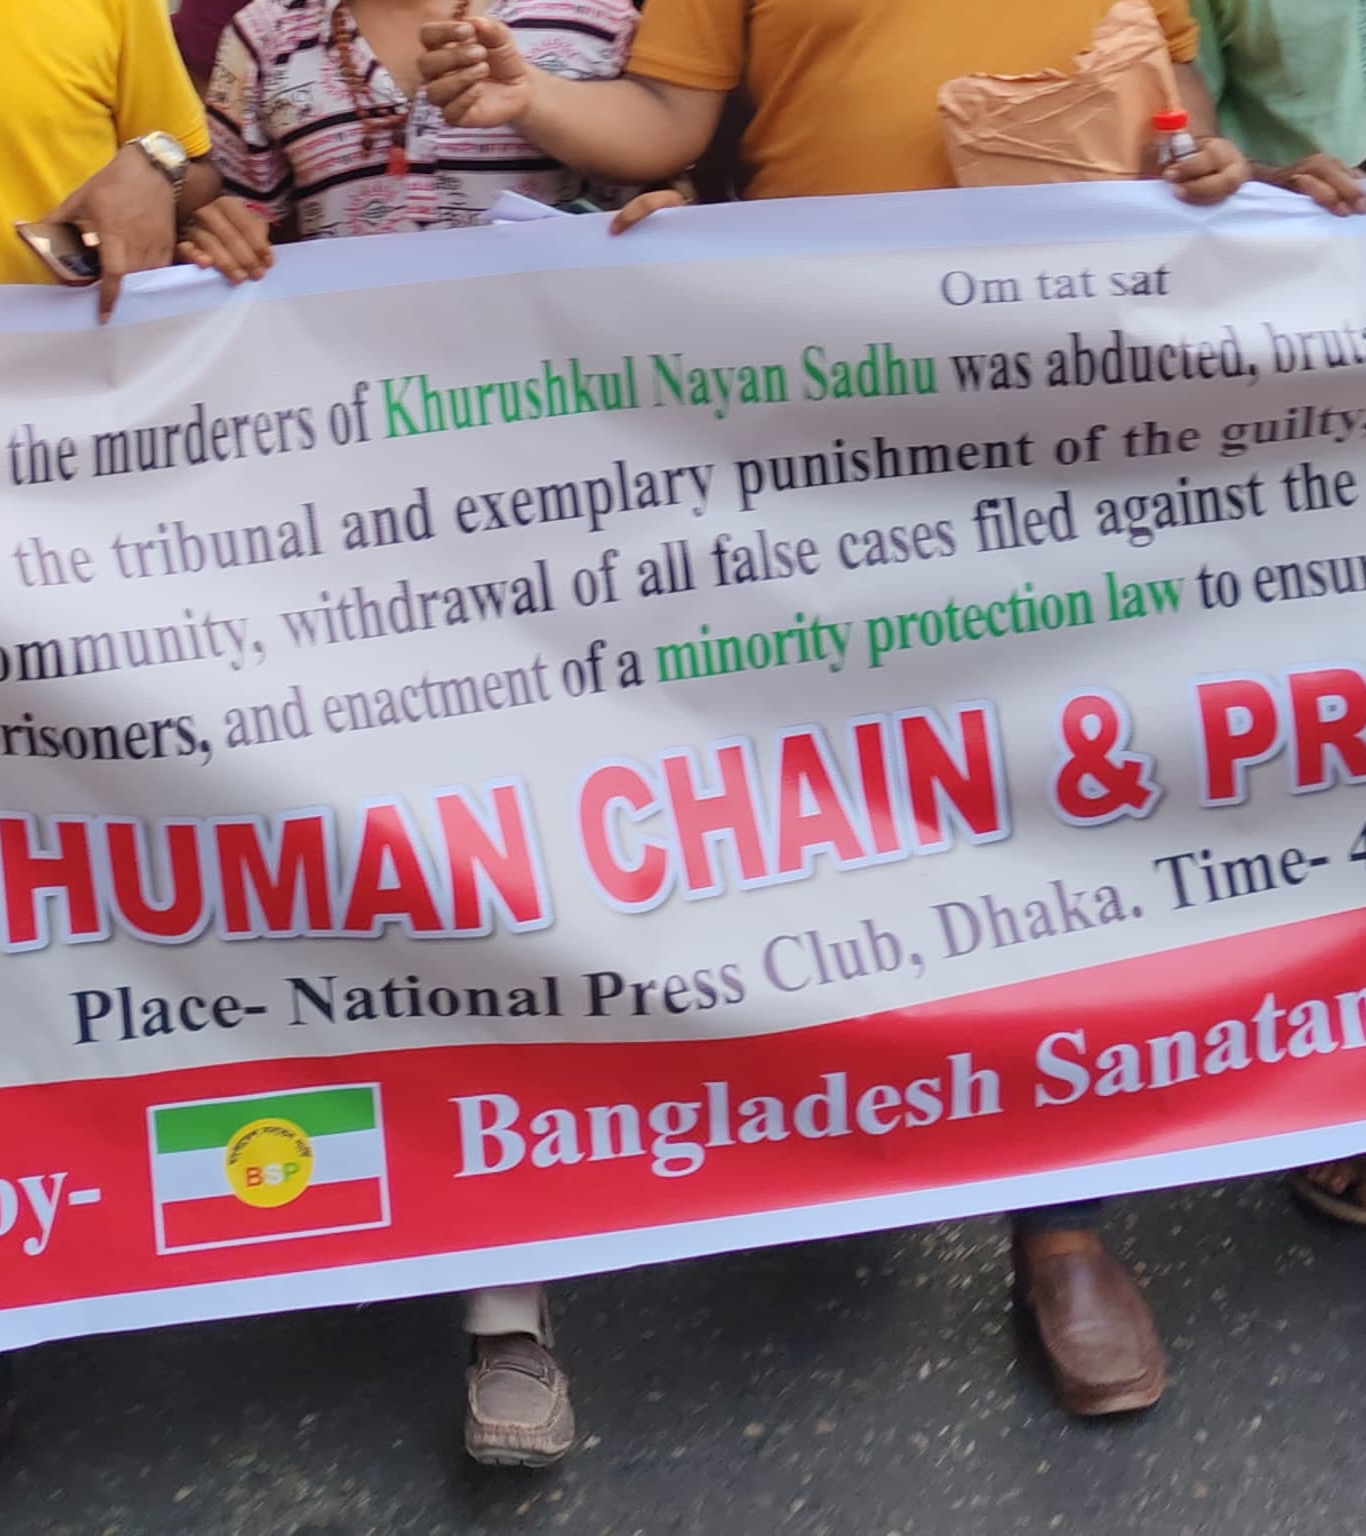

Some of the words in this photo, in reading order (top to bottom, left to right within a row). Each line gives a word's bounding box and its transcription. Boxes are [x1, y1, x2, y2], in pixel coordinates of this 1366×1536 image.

[941, 270, 1024, 306] Om
[1034, 267, 1096, 301] tat
[1109, 263, 1171, 298] sat
[9, 423, 76, 485] the
[92, 403, 314, 478] murderers
[329, 381, 371, 446] of
[380, 356, 641, 440] Khurushkul
[649, 352, 788, 420] Nayan
[801, 342, 938, 402] Sadhu
[951, 352, 1032, 392] was
[1047, 324, 1259, 388] abducted,
[12, 535, 95, 588] the
[111, 503, 325, 580] tribunal
[340, 486, 435, 552] and
[455, 460, 714, 536] exemplary
[734, 431, 1034, 512] punishment
[1055, 423, 1108, 466] of
[1124, 419, 1201, 457] the
[279, 558, 556, 649] withdrawal
[573, 548, 620, 608] of
[637, 539, 696, 599] all
[711, 529, 821, 588] false
[838, 517, 957, 571] cases
[971, 489, 1079, 553] filed
[1096, 472, 1267, 547] against
[1283, 462, 1359, 514] the
[223, 684, 313, 750] and
[322, 652, 551, 737] enactment
[562, 638, 607, 697] of
[616, 645, 646, 690] a
[654, 611, 852, 684] minority
[865, 582, 1096, 669] protection
[1104, 571, 1185, 622] law
[1197, 564, 1243, 610] to
[575, 706, 1006, 911] CHAIN
[1051, 689, 1158, 822] &
[71, 978, 266, 1046] Place-
[288, 975, 563, 1027] National
[585, 962, 746, 1019] Press
[762, 917, 927, 994] Club,
[931, 876, 1143, 961] Dhaka.
[1154, 846, 1330, 913] Time-
[246, 1161, 300, 1188] BSP
[449, 1050, 1002, 1180] Bangladesh
